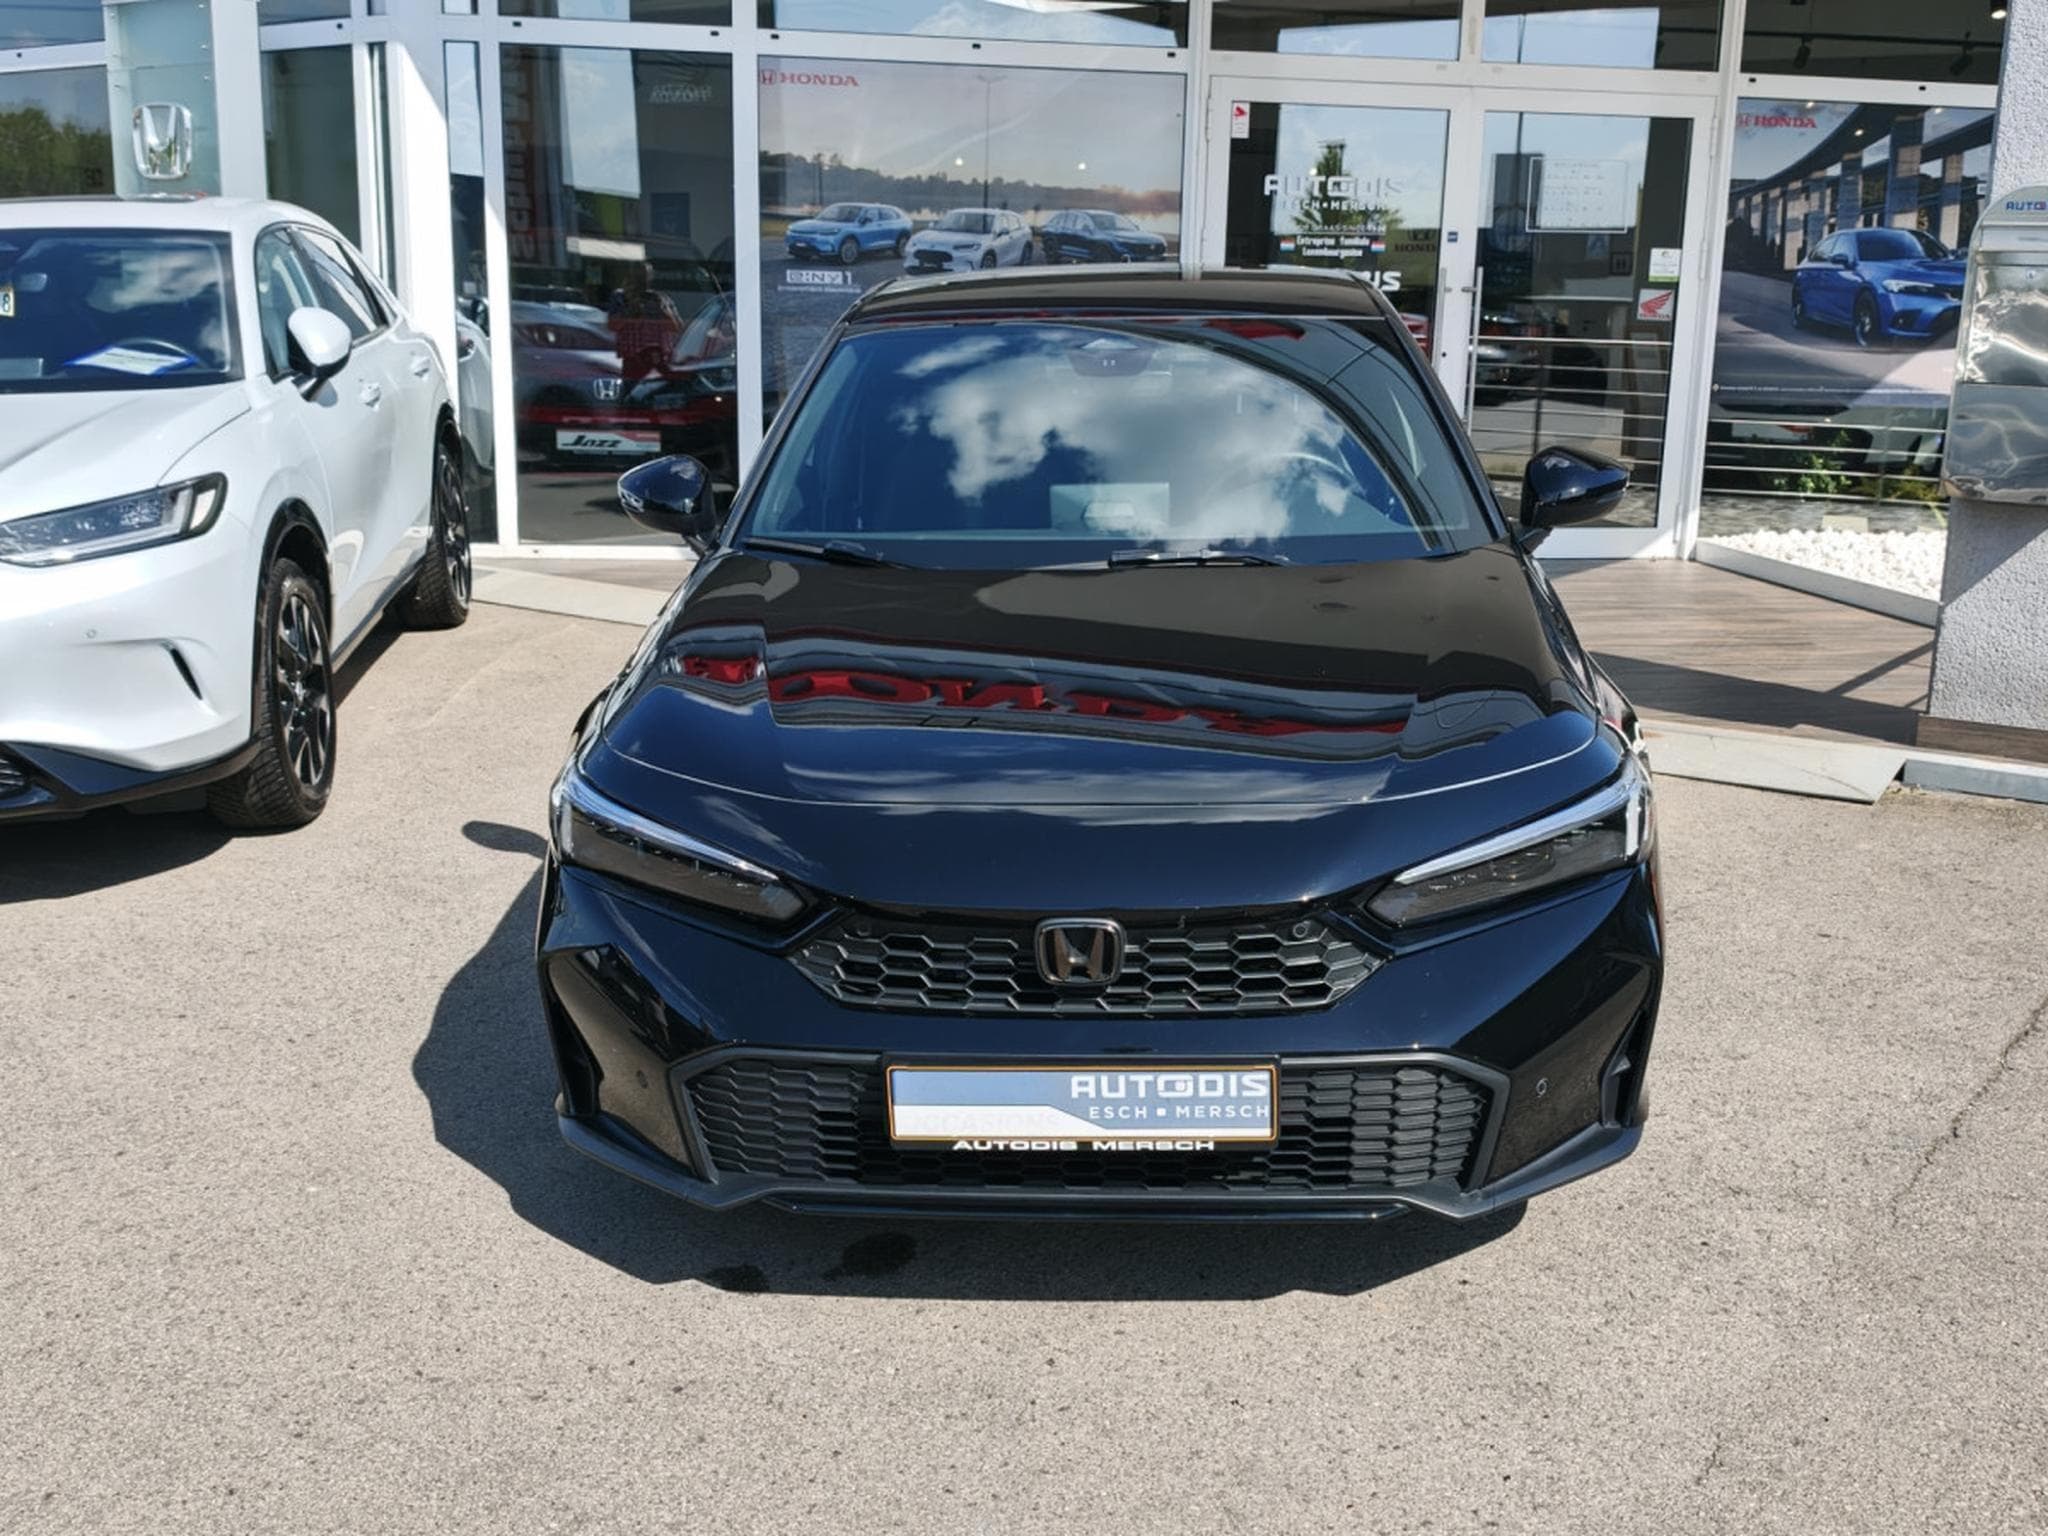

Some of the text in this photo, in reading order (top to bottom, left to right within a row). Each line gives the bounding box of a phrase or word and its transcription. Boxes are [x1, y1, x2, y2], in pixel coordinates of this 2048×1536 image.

[780, 71, 860, 87] HONDA
[1753, 114, 1817, 129] HONDA
[2006, 200, 2047, 211] AUTO
[1394, 243, 1436, 251] HOND
[561, 434, 622, 447] Jazz
[1070, 1073, 1270, 1099] AUTODIS
[1089, 1105, 1270, 1119] ESCH MERSCH
[952, 1140, 1215, 1151] AUTODIS MERSCH
